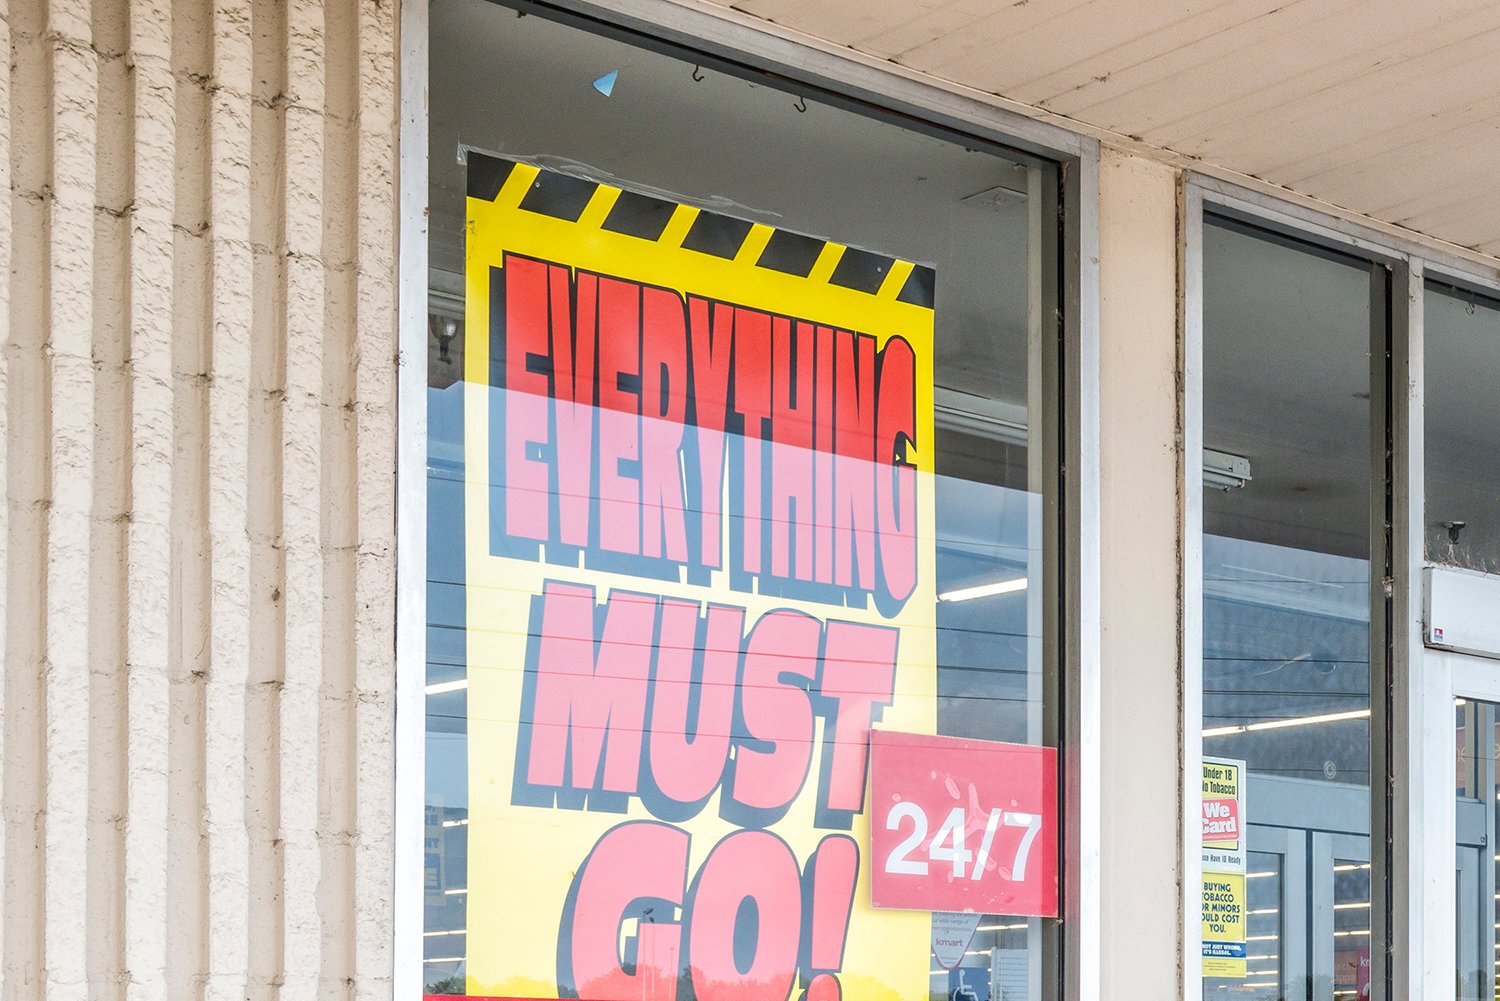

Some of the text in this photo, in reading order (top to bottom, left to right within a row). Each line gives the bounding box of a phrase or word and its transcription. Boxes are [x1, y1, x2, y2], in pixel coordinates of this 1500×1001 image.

[490, 250, 918, 620] EVERYTHING
[511, 578, 900, 830] MUST
[1203, 767, 1233, 781] Under 18
[1210, 781, 1236, 795] Tobacco
[1203, 802, 1230, 818] We
[884, 800, 1043, 883] 24/7
[1203, 882, 1231, 892] BUYING
[1211, 903, 1240, 913] MINORS
[1221, 914, 1240, 923] COST
[1209, 924, 1227, 933] YOU.
[936, 938, 964, 947] kmart
